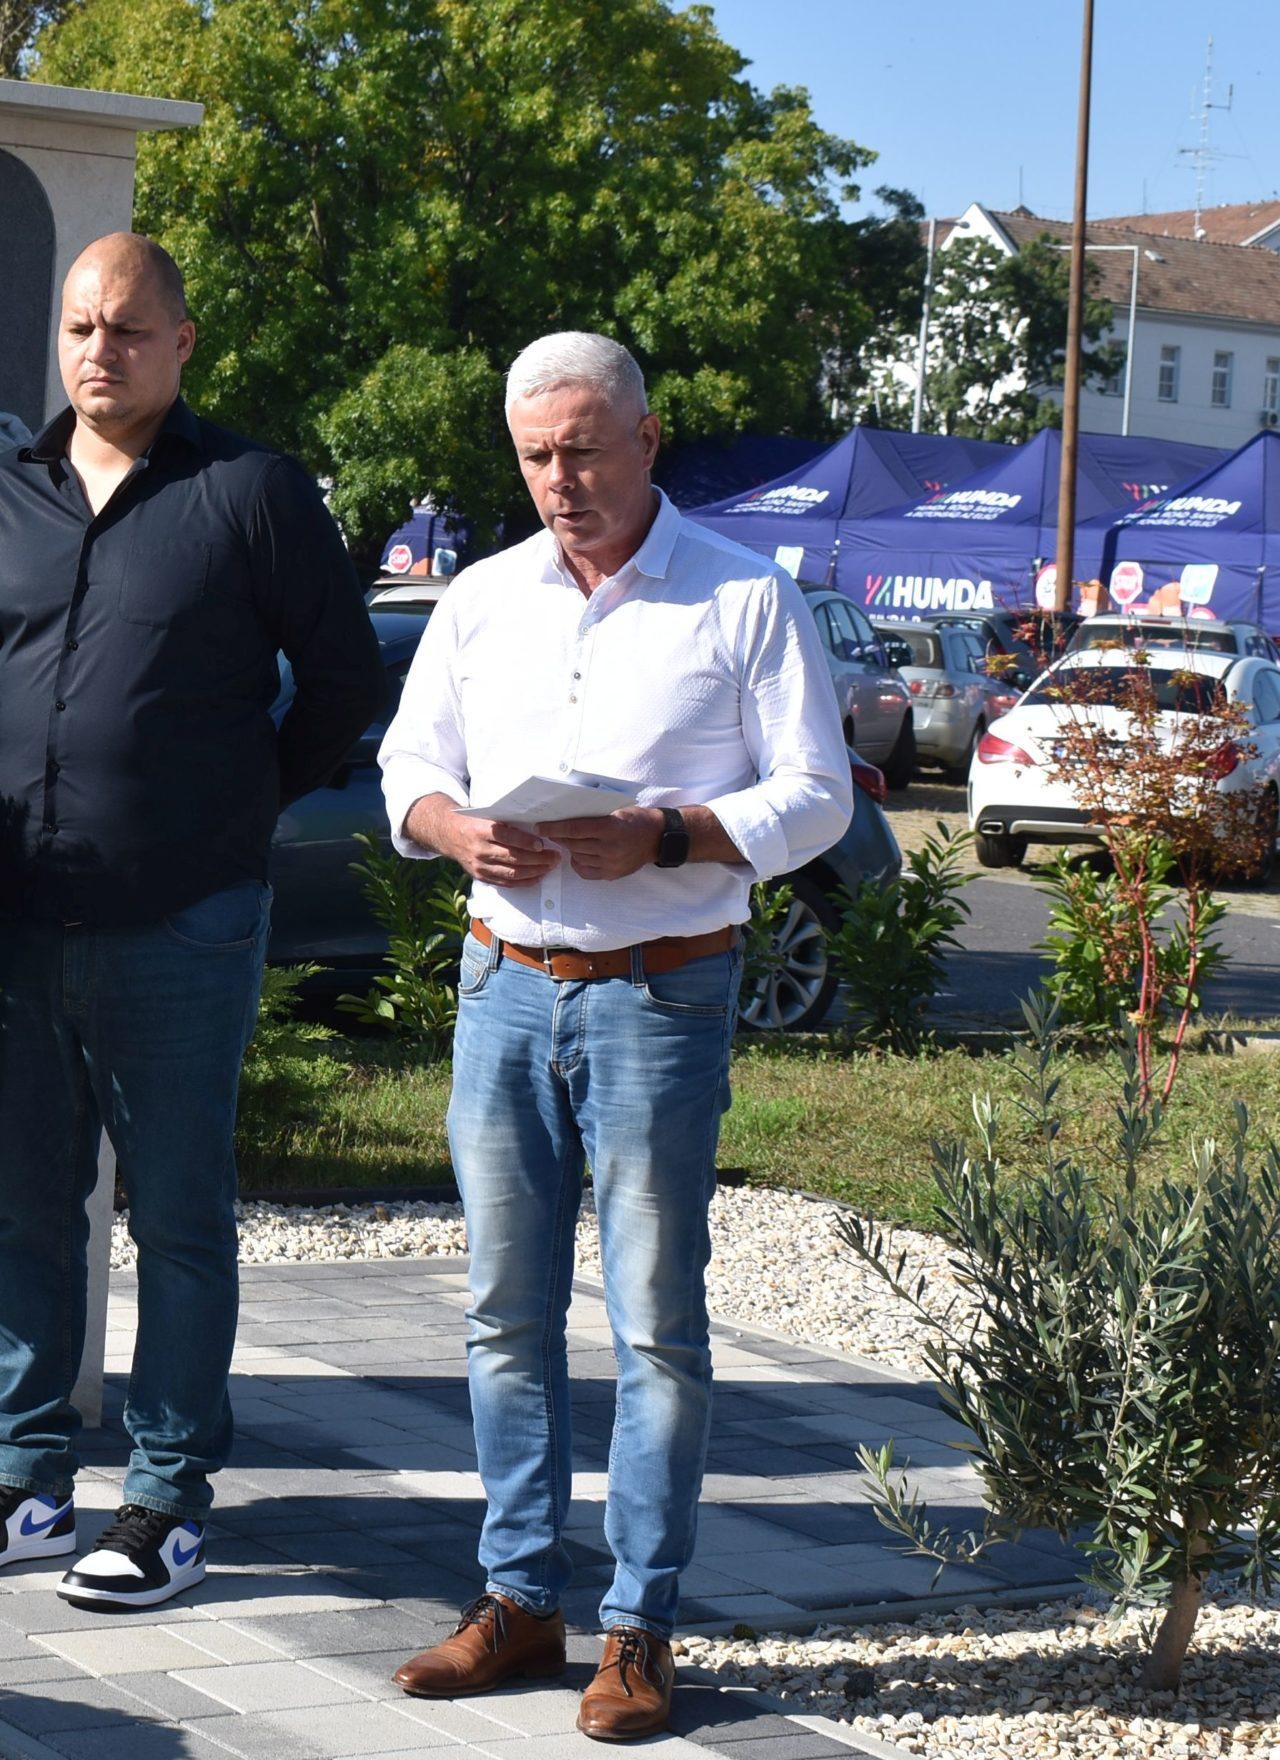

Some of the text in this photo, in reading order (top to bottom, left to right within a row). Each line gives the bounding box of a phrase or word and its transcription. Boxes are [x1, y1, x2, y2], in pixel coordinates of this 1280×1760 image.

[943, 489, 1023, 508] HUMDA
[1158, 496, 1242, 515] HUMDA
[892, 575, 994, 611] HUMDA
